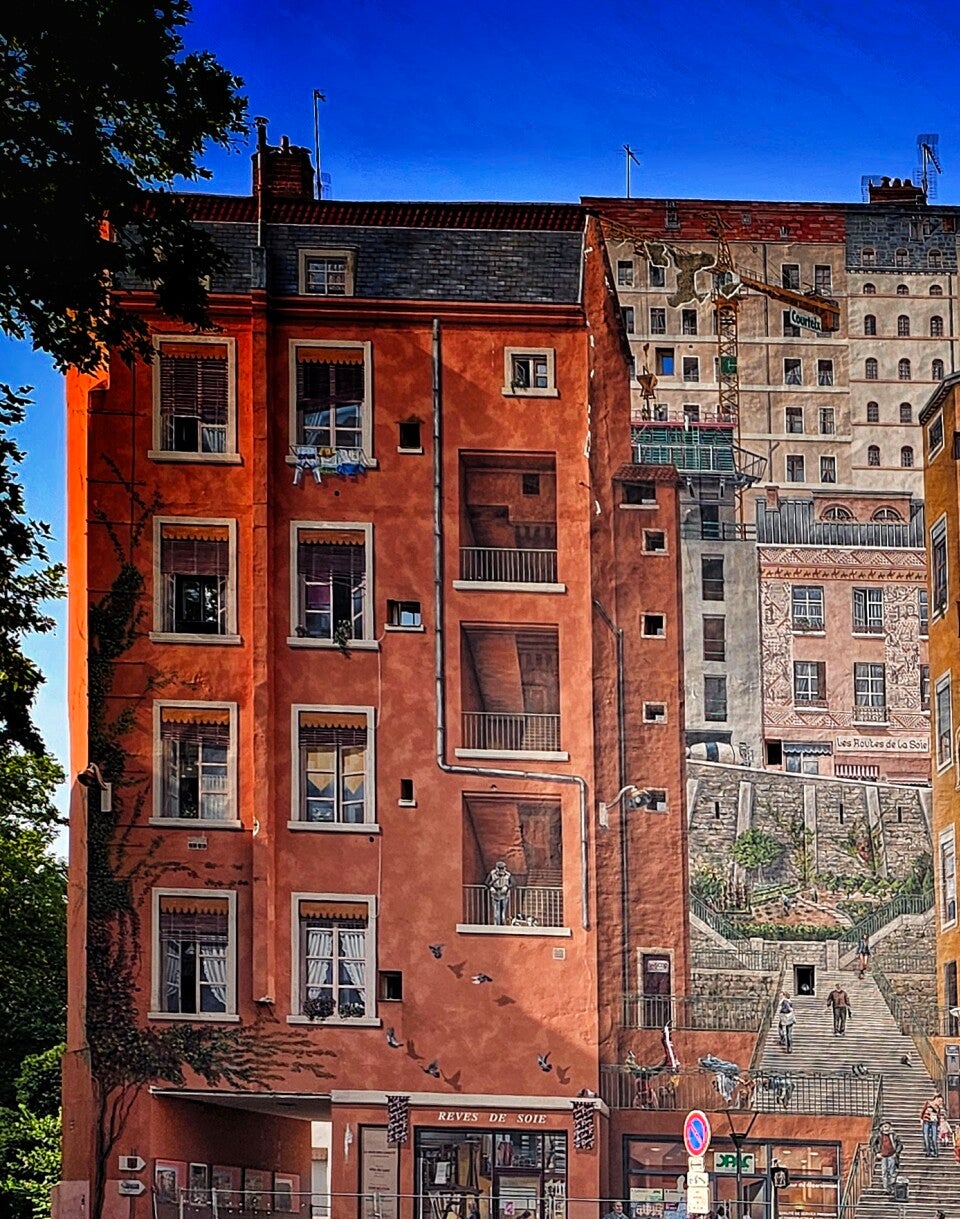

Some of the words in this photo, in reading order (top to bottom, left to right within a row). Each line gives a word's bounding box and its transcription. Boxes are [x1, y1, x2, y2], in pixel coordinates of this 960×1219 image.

[791, 310, 821, 330] Courteix
[854, 739, 884, 748] Routes
[886, 740, 896, 749] de
[898, 740, 908, 749] la
[909, 740, 928, 749] Soie
[438, 1111, 479, 1122] REVES
[489, 1113, 507, 1123] DE
[516, 1114, 548, 1124] SOIE
